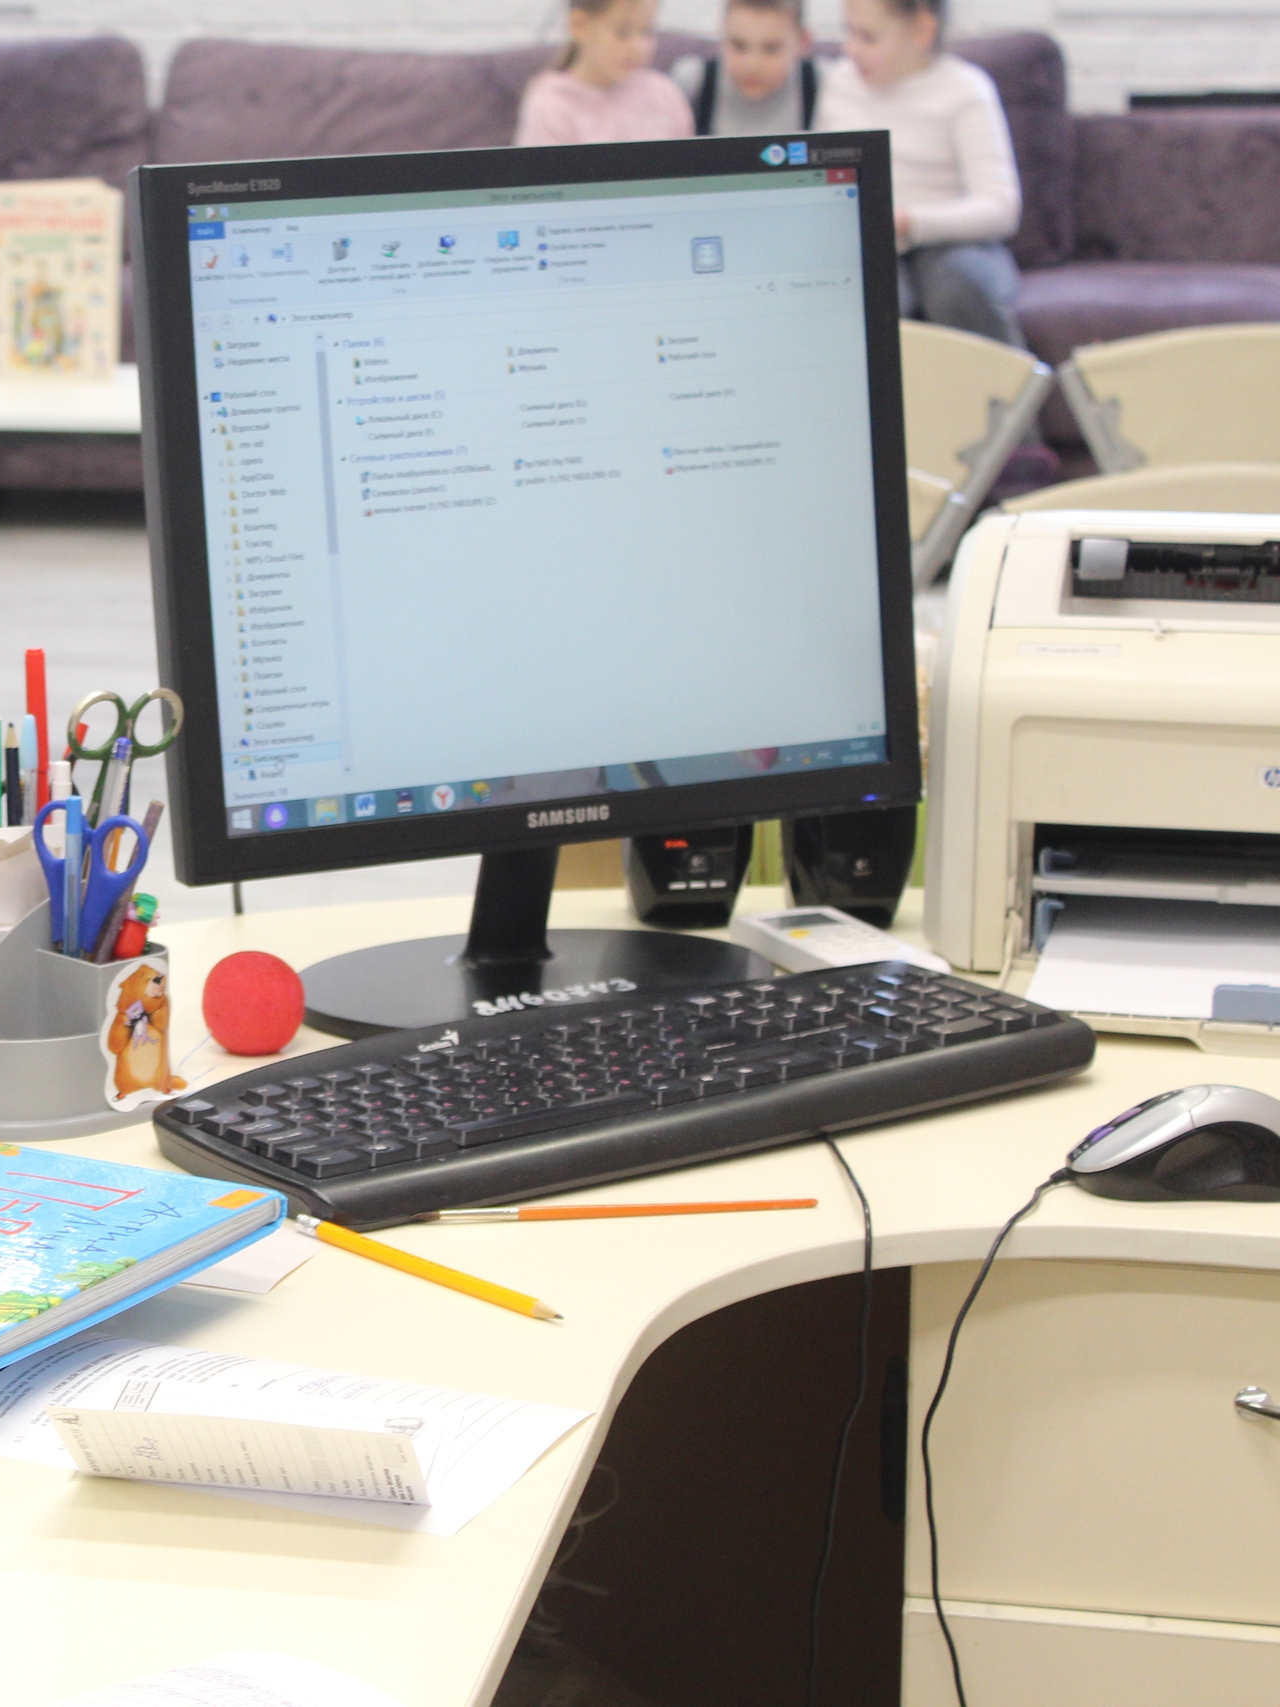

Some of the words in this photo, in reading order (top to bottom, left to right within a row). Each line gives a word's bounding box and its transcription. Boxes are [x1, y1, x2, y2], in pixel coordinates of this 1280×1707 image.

[187, 182, 249, 195] SyncMaster
[250, 178, 281, 192] E1920
[527, 805, 610, 828] SAMSUNG
